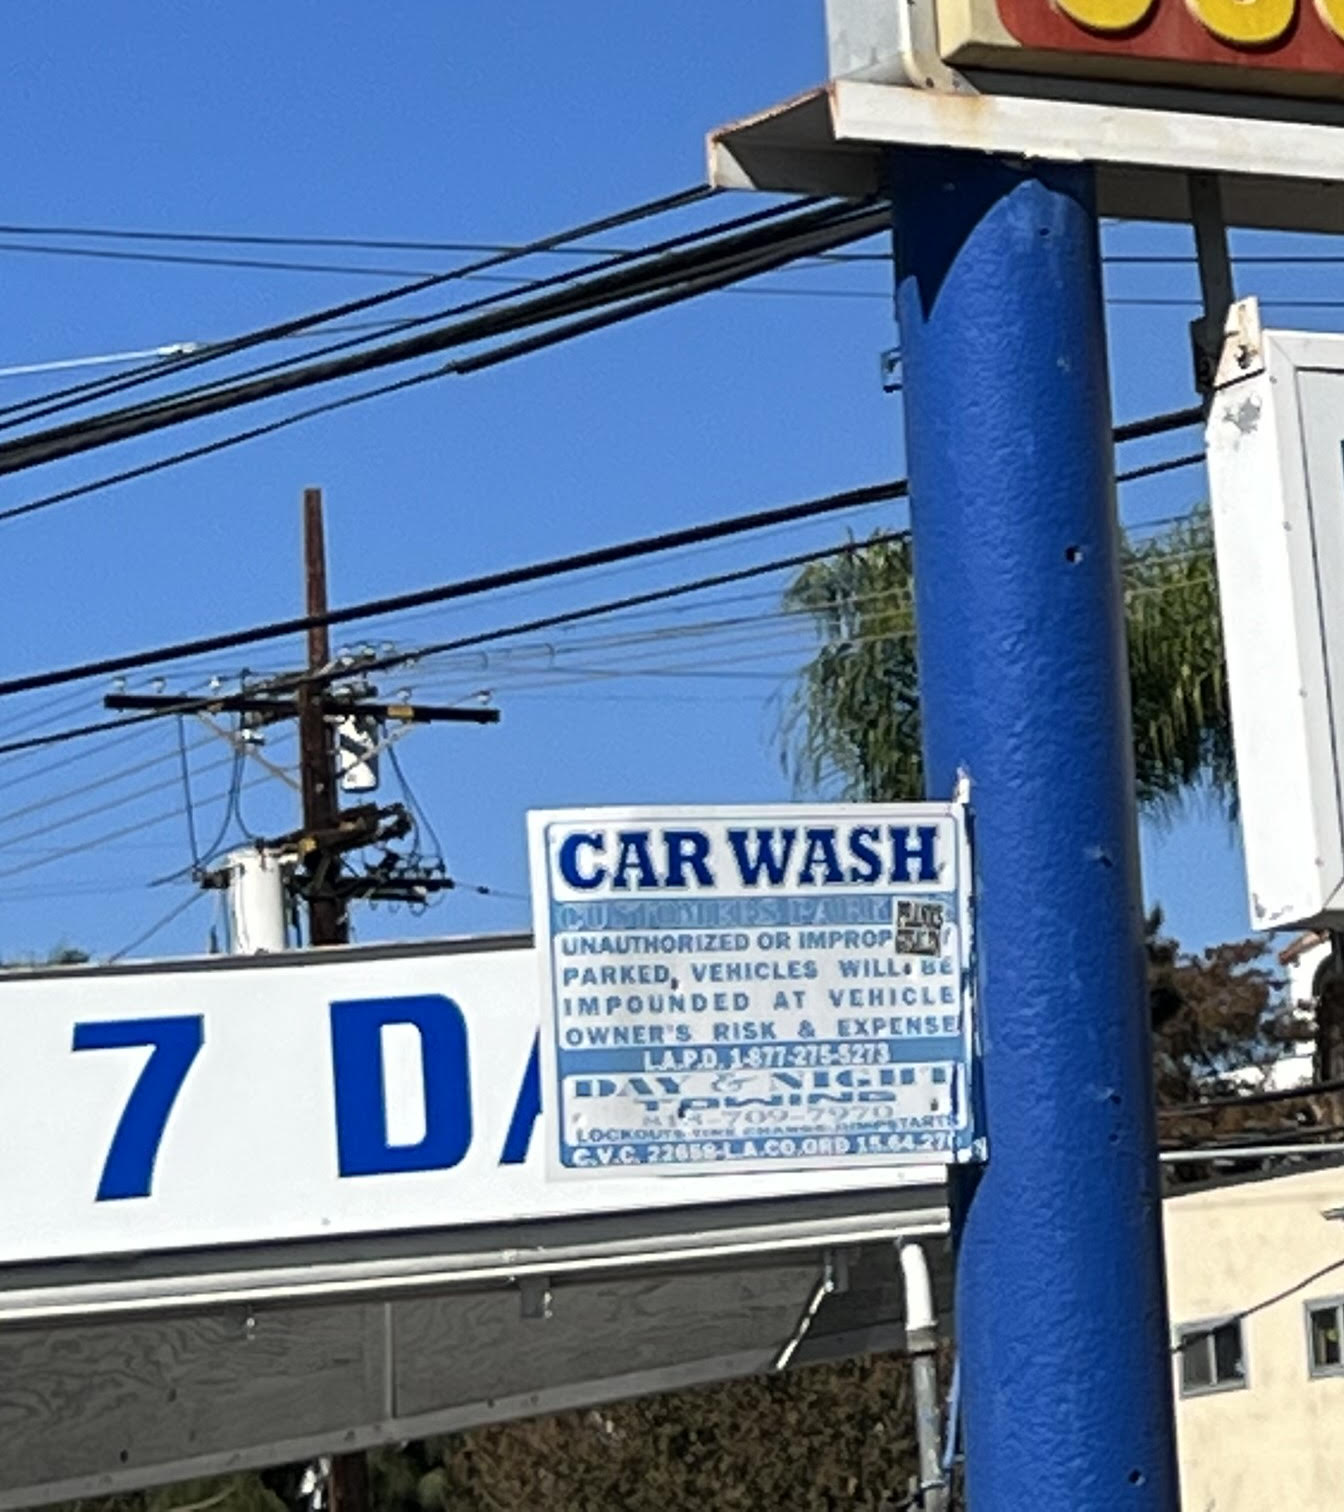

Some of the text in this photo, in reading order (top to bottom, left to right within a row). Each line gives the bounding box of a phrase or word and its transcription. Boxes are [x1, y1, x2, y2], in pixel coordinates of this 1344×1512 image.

[558, 825, 942, 890] CAR WASH
[562, 927, 952, 956] UNAUTHORIZED OR IMPROP
[690, 959, 818, 983] VEHICLES
[838, 958, 900, 979] WILL
[921, 955, 954, 976] BE
[564, 985, 956, 1016] IMPOUNDED AT VEHICLE
[565, 1015, 956, 1046] OWNER'S RISK & EXPENSE
[72, 1014, 205, 1203] 7
